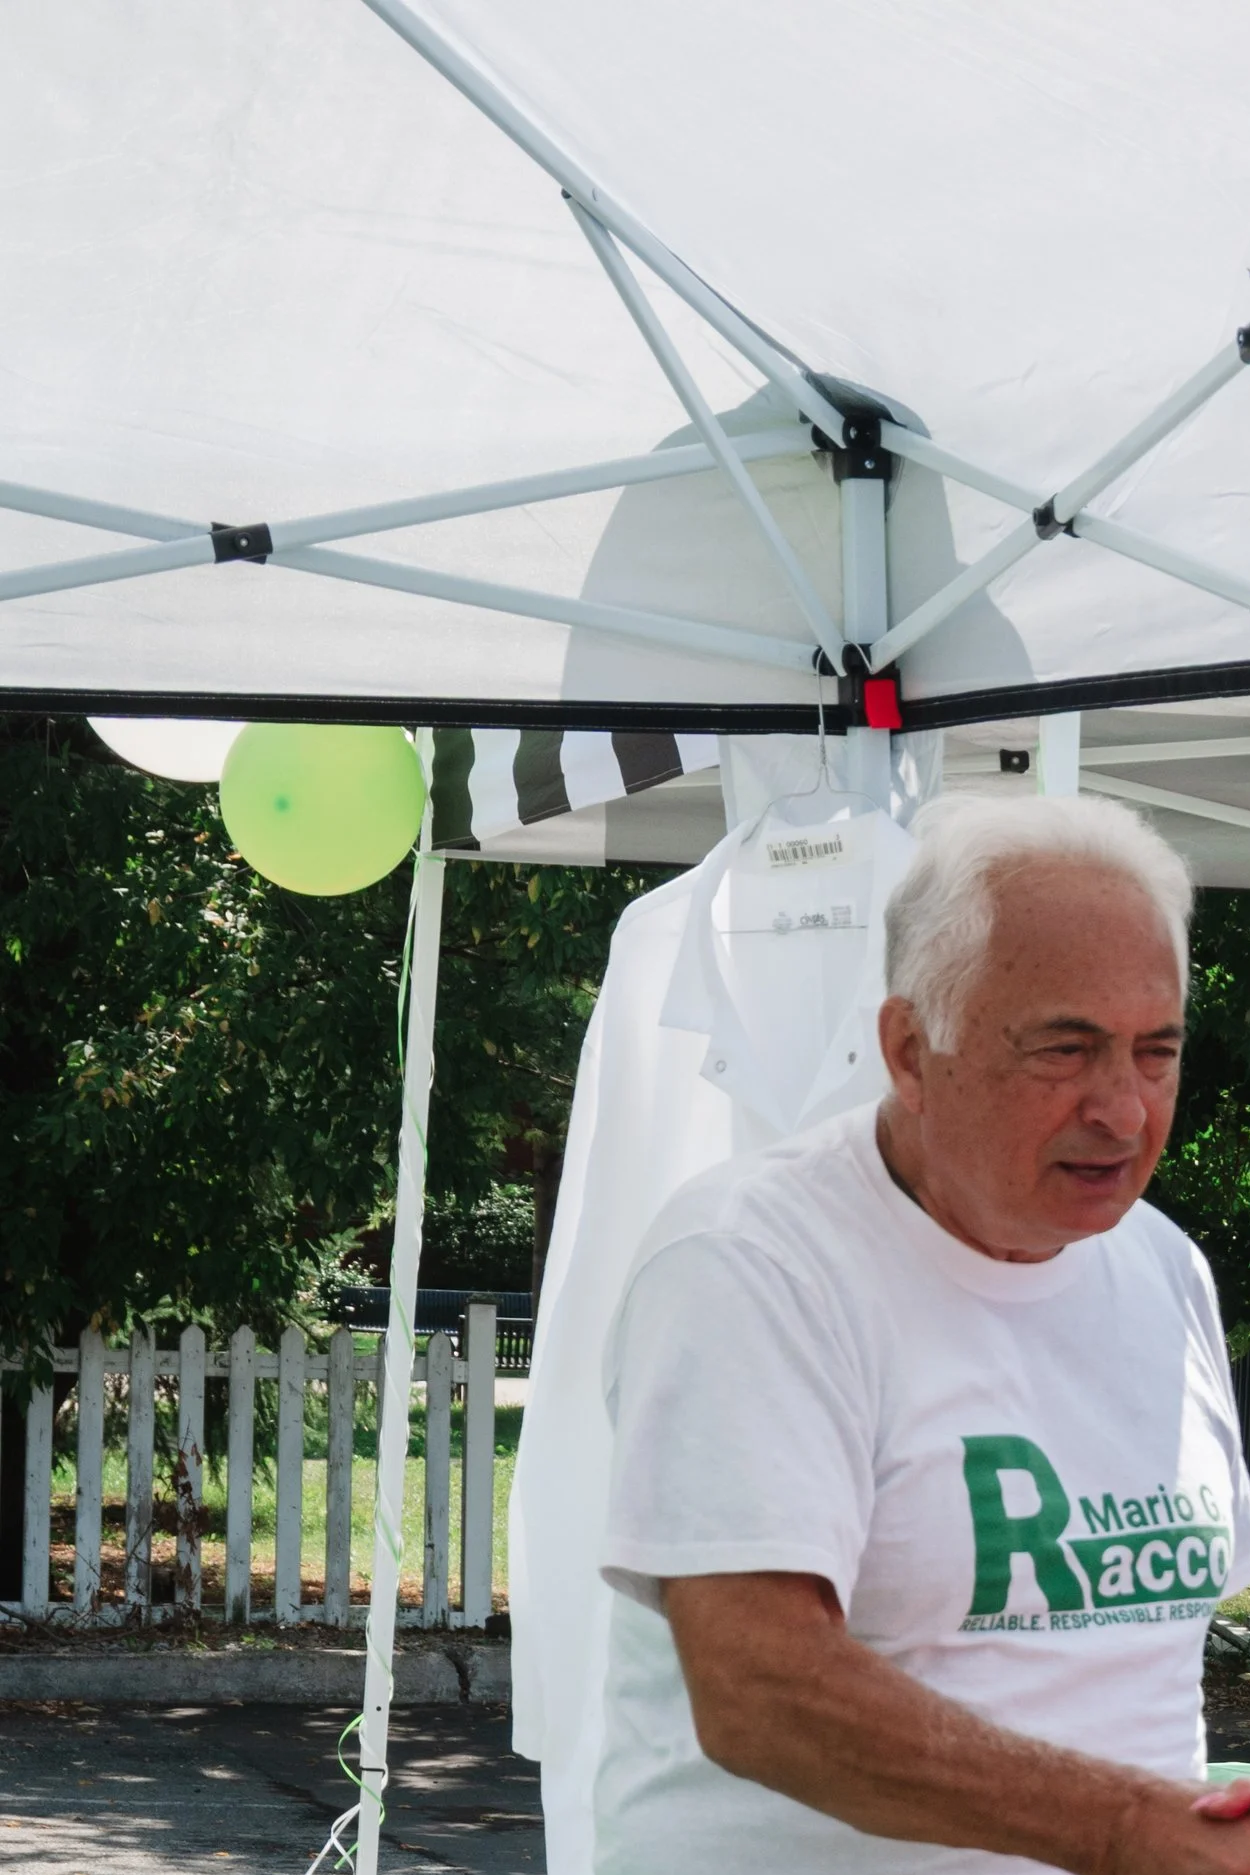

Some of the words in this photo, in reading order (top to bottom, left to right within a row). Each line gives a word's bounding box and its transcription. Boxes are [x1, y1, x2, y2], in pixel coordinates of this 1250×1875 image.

[1078, 1484, 1194, 1535] Mario
[958, 1614, 1044, 1632] RELIABLE.
[1050, 1606, 1163, 1631] RESPONSIBLE.
